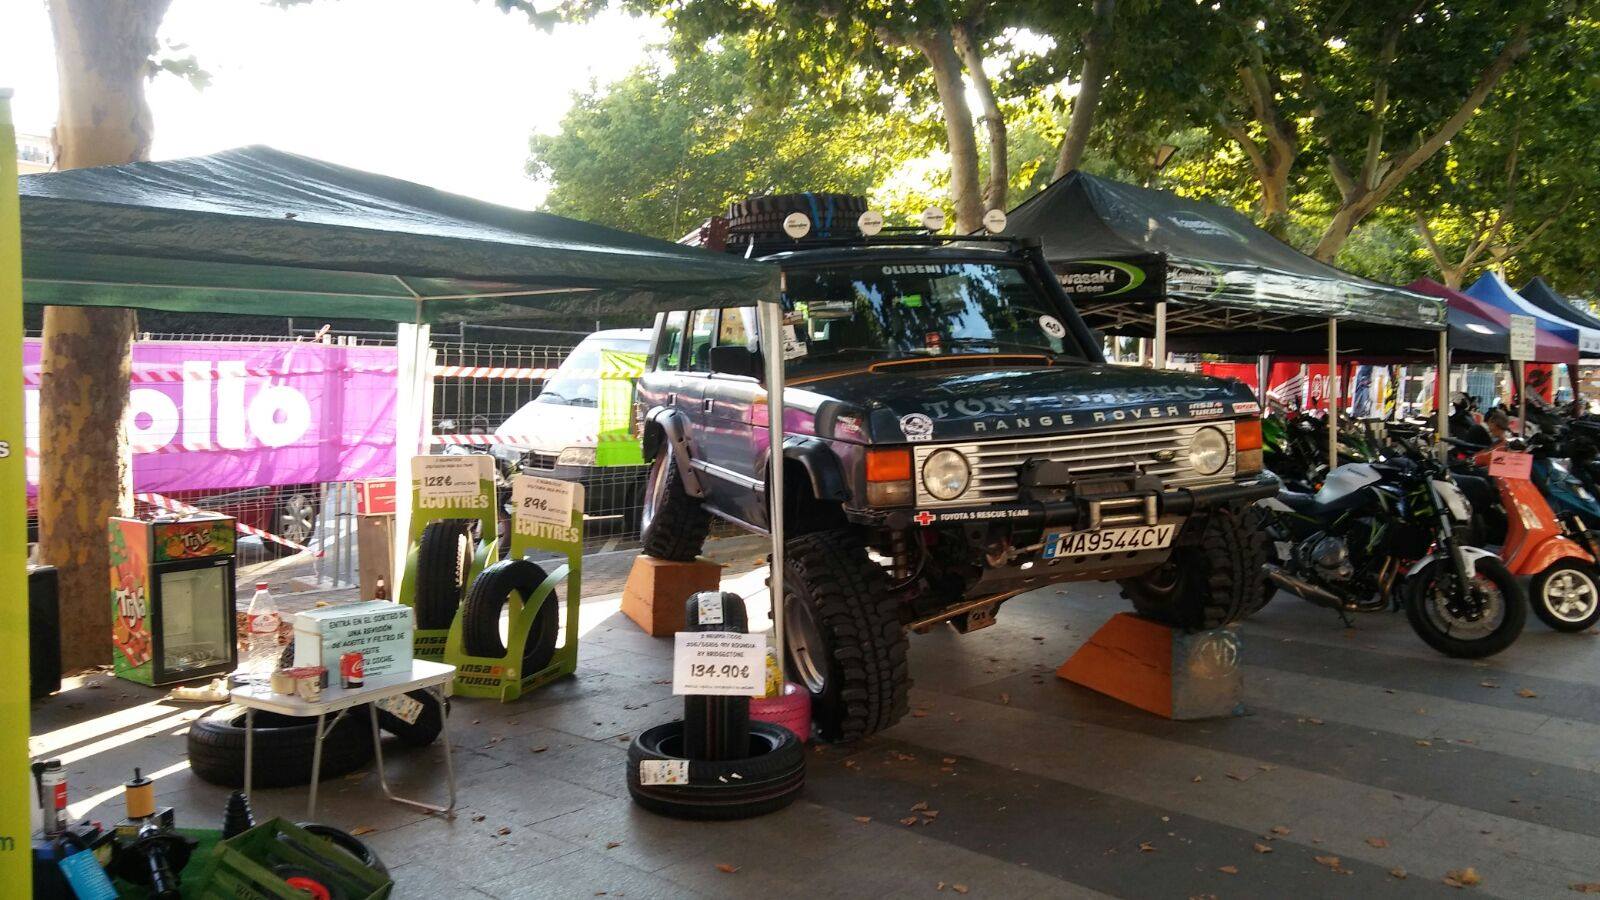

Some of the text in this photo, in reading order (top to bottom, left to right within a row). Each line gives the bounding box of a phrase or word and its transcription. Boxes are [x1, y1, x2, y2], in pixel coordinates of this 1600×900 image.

[1056, 270, 1115, 285] wasaki
[973, 405, 1179, 432] RANGE ROVER
[1188, 408, 1224, 416] TURBO
[424, 475, 452, 487] 128€
[523, 497, 548, 511] 89€
[940, 513, 969, 521] TOYOTA
[976, 511, 1006, 519] RESCUE
[1006, 509, 1030, 517] TEAM
[515, 519, 579, 543] ECOTYRES
[1059, 527, 1170, 554] MA9544CV
[329, 620, 351, 629] ENTRA
[373, 612, 398, 622] SORTEO
[399, 610, 408, 619] DE
[373, 634, 395, 643] FILTRO
[397, 632, 405, 640] DE
[361, 646, 380, 655] CEITE
[691, 664, 750, 678] 134.90€
[458, 675, 502, 687] TURBO
